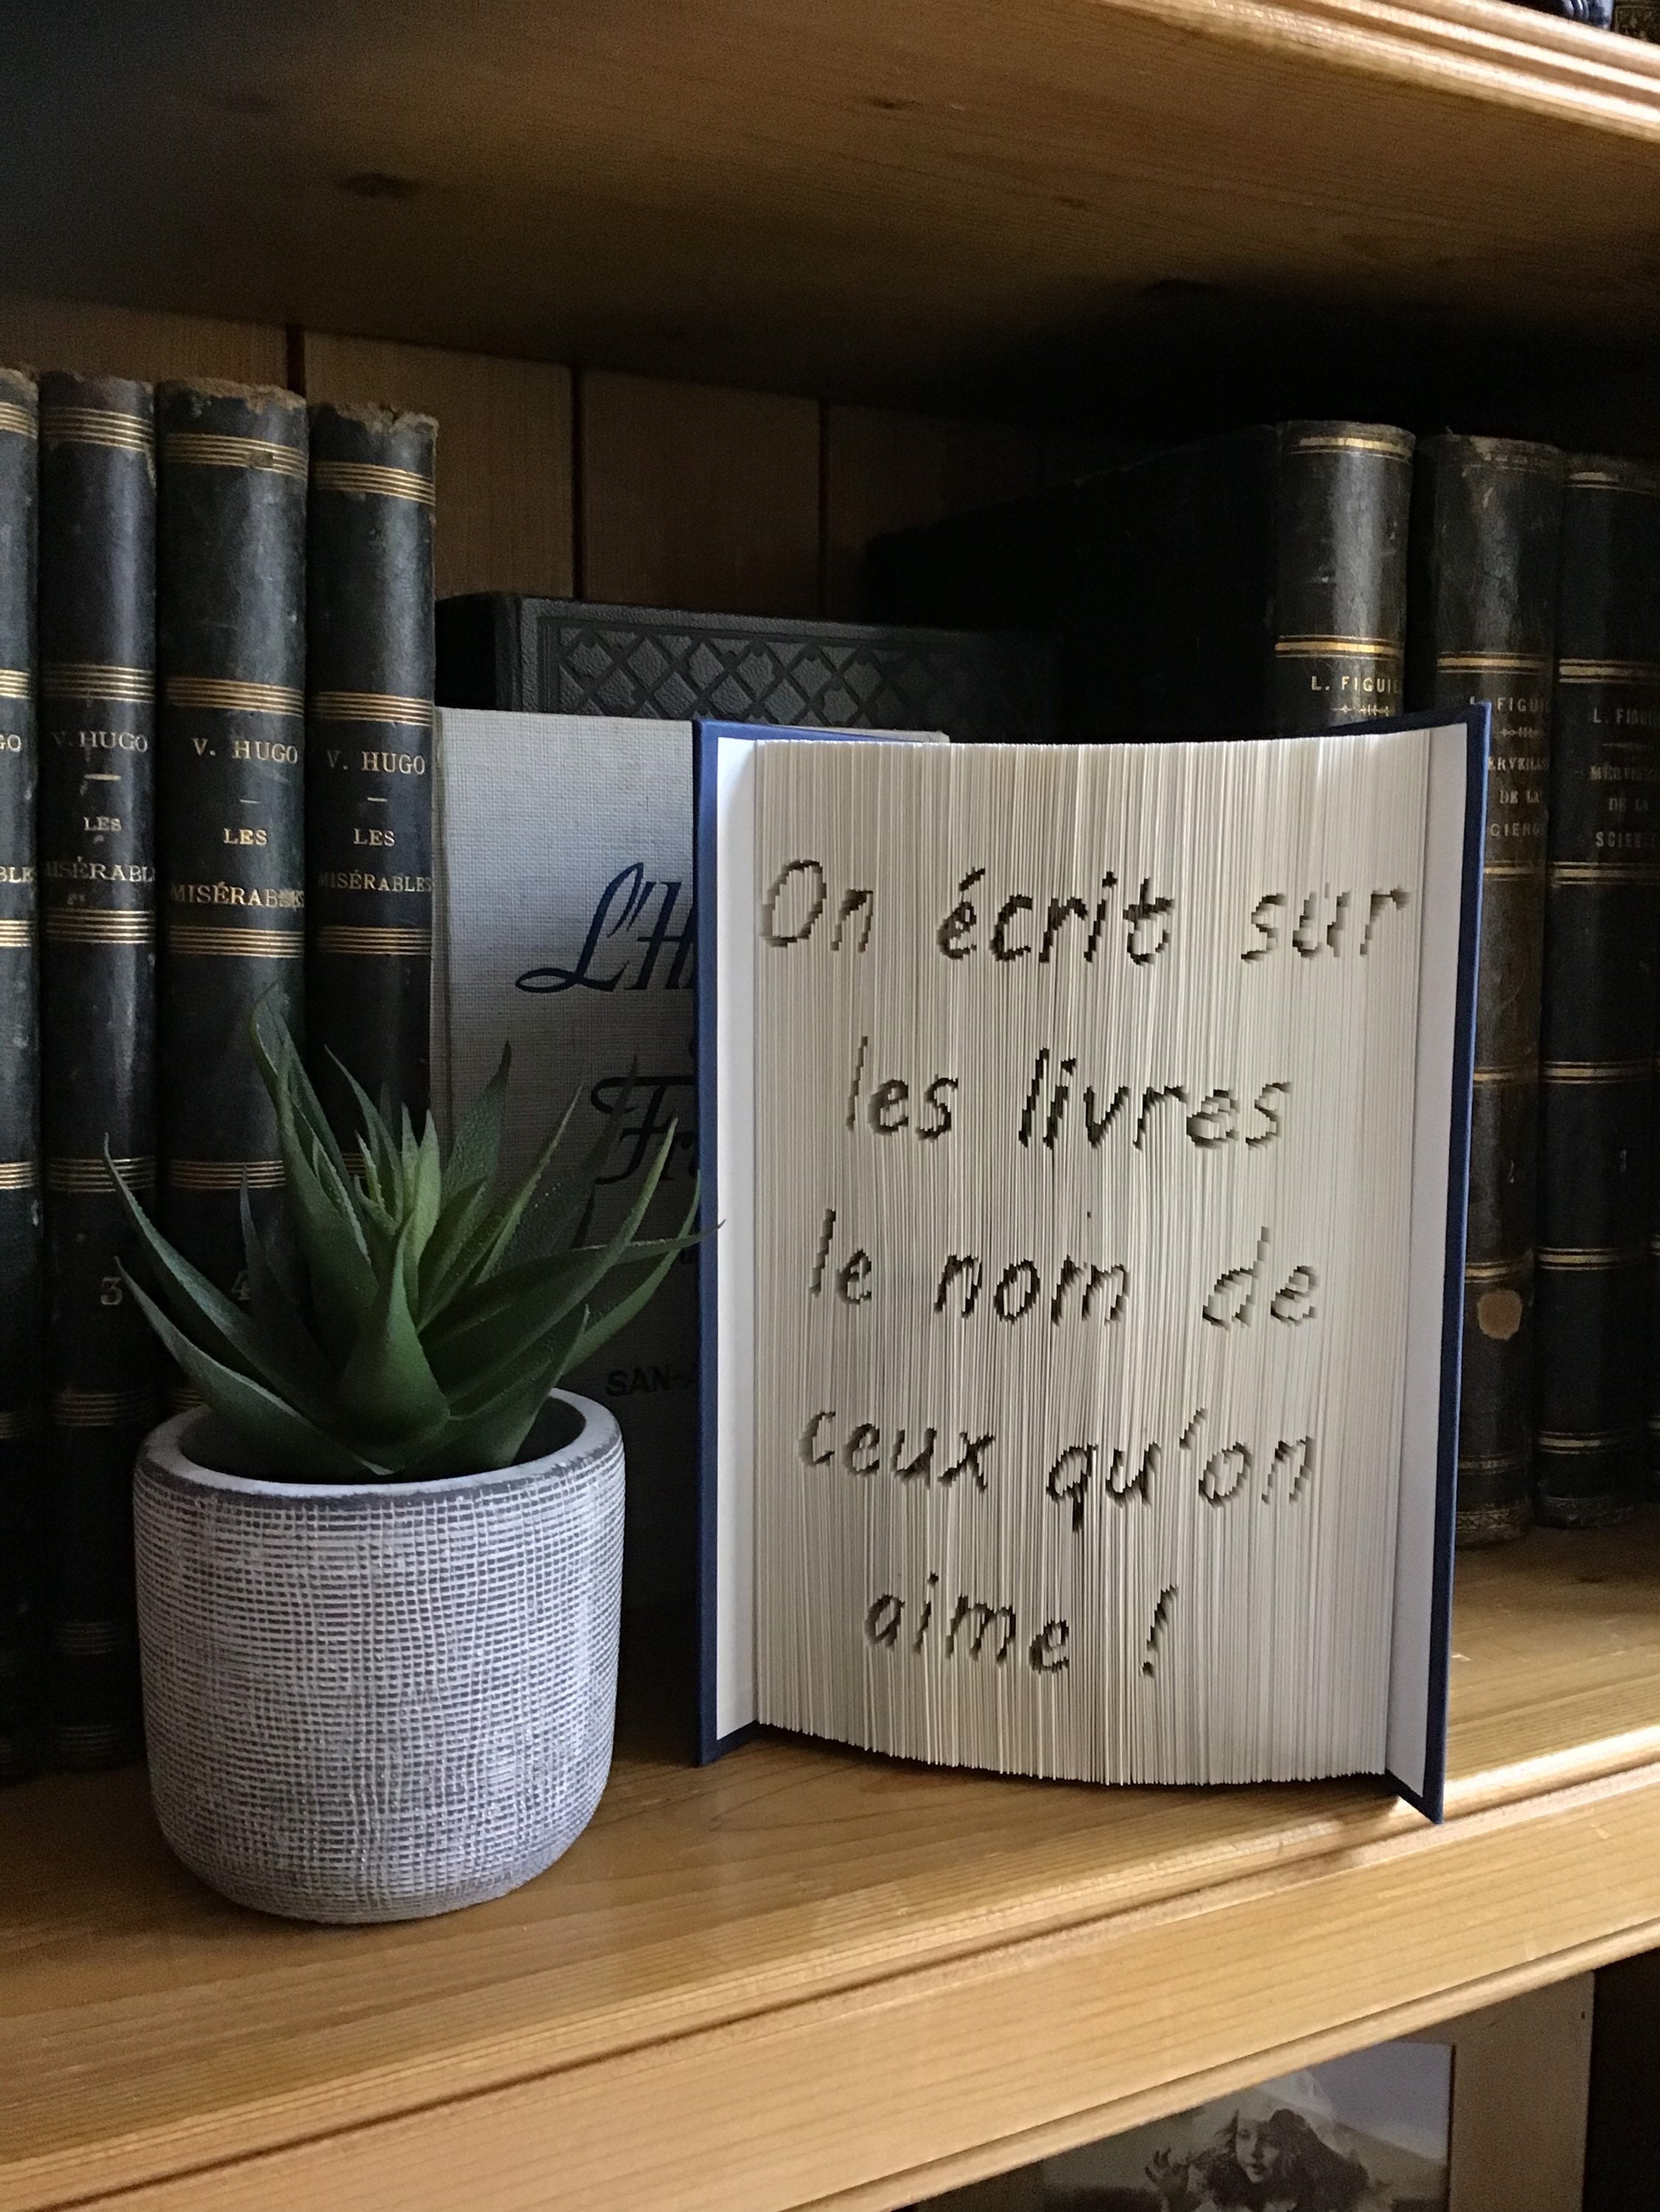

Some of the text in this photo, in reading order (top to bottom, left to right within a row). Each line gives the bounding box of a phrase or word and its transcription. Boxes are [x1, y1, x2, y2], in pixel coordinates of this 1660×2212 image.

[1311, 676, 1330, 692] L.
[78, 730, 148, 753] HUGO
[191, 738, 298, 765] V. HUGO
[326, 749, 426, 774] V. HUGO
[83, 815, 123, 832] LES
[223, 828, 268, 845] LES
[352, 828, 396, 847] LES
[318, 868, 433, 893] MISÉRABLES
[761, 859, 1411, 965] On écrit sur
[846, 1036, 1291, 1150] les livres
[809, 1208, 1318, 1330] le nom de
[100, 1275, 123, 1306] 3
[230, 1269, 252, 1301] 4
[798, 1406, 1317, 1533] ceux qu'on
[864, 1572, 1179, 1678] aime !
